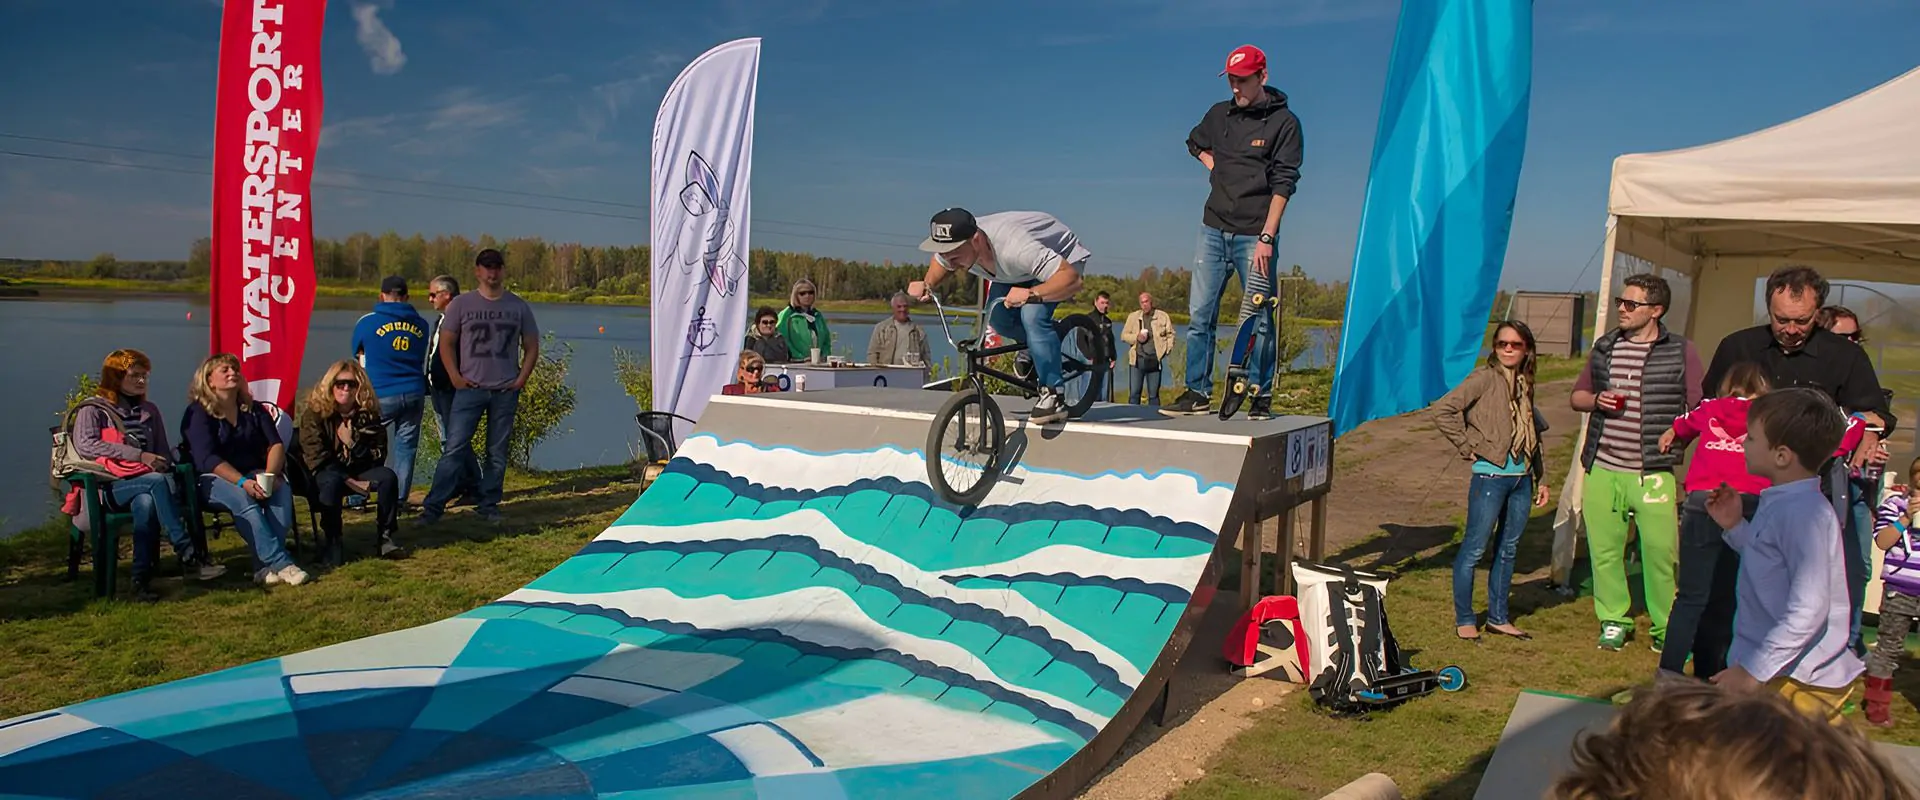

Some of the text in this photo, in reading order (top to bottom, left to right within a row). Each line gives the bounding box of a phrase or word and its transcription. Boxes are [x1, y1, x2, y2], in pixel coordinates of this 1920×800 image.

[270, 64, 303, 304] CENTER
[469, 322, 518, 359] 27
[1705, 440, 1745, 453] adida
[1638, 474, 1669, 503] 2
